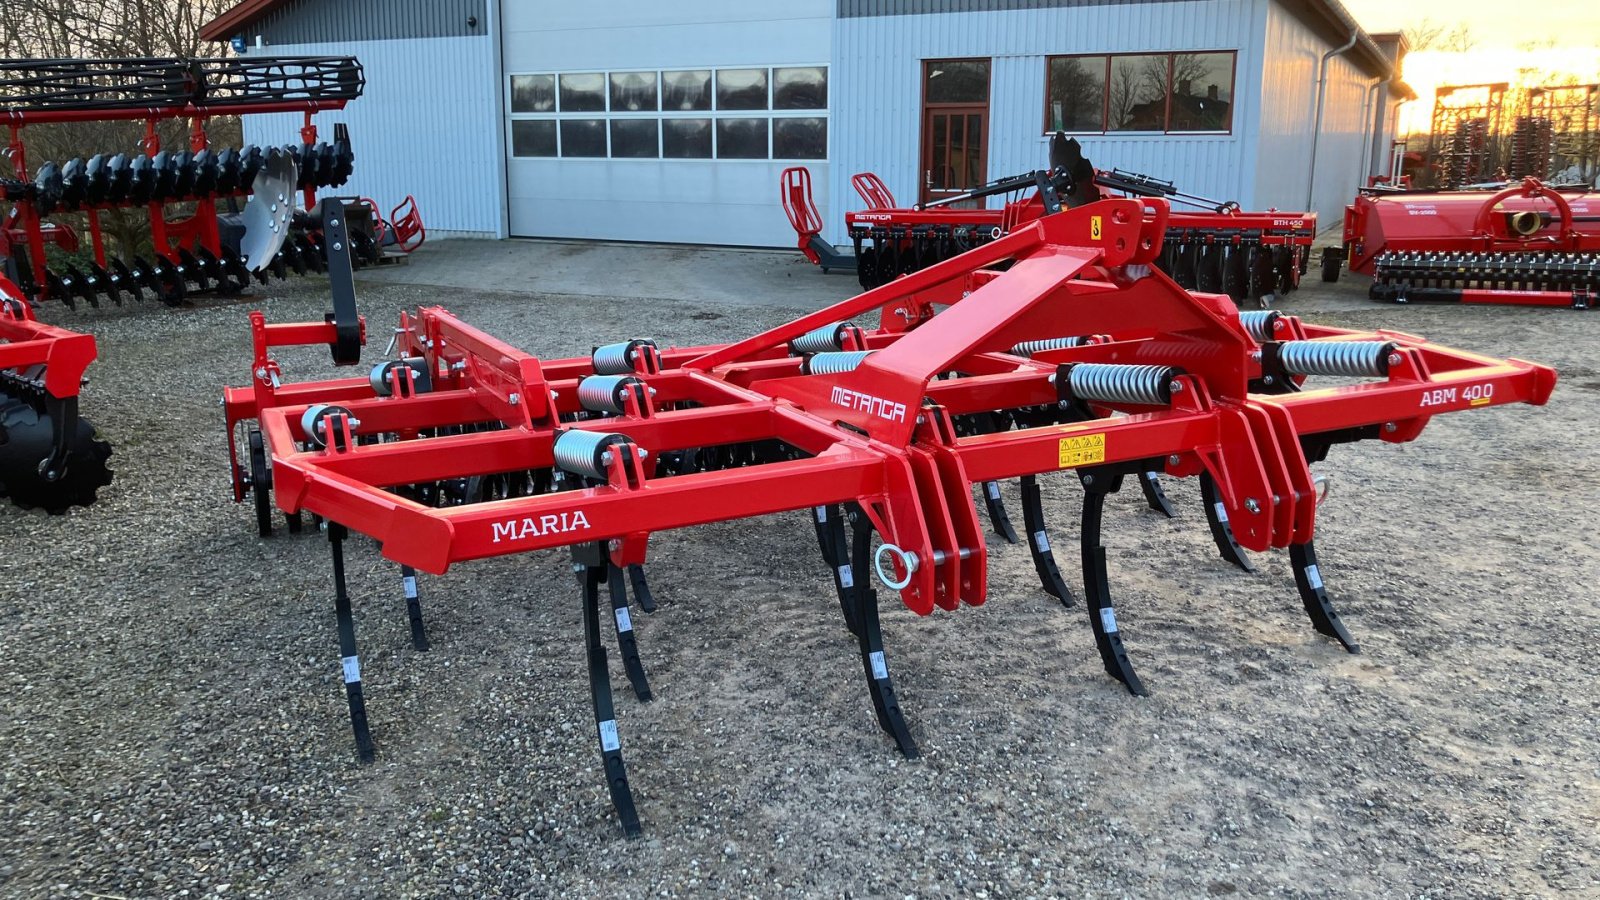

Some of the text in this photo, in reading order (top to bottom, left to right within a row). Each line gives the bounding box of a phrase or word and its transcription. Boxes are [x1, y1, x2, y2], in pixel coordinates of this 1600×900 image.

[854, 213, 892, 221] METANGA
[830, 385, 907, 424] METANGA
[1419, 383, 1493, 407] ABM 400
[491, 510, 591, 543] MARIA
